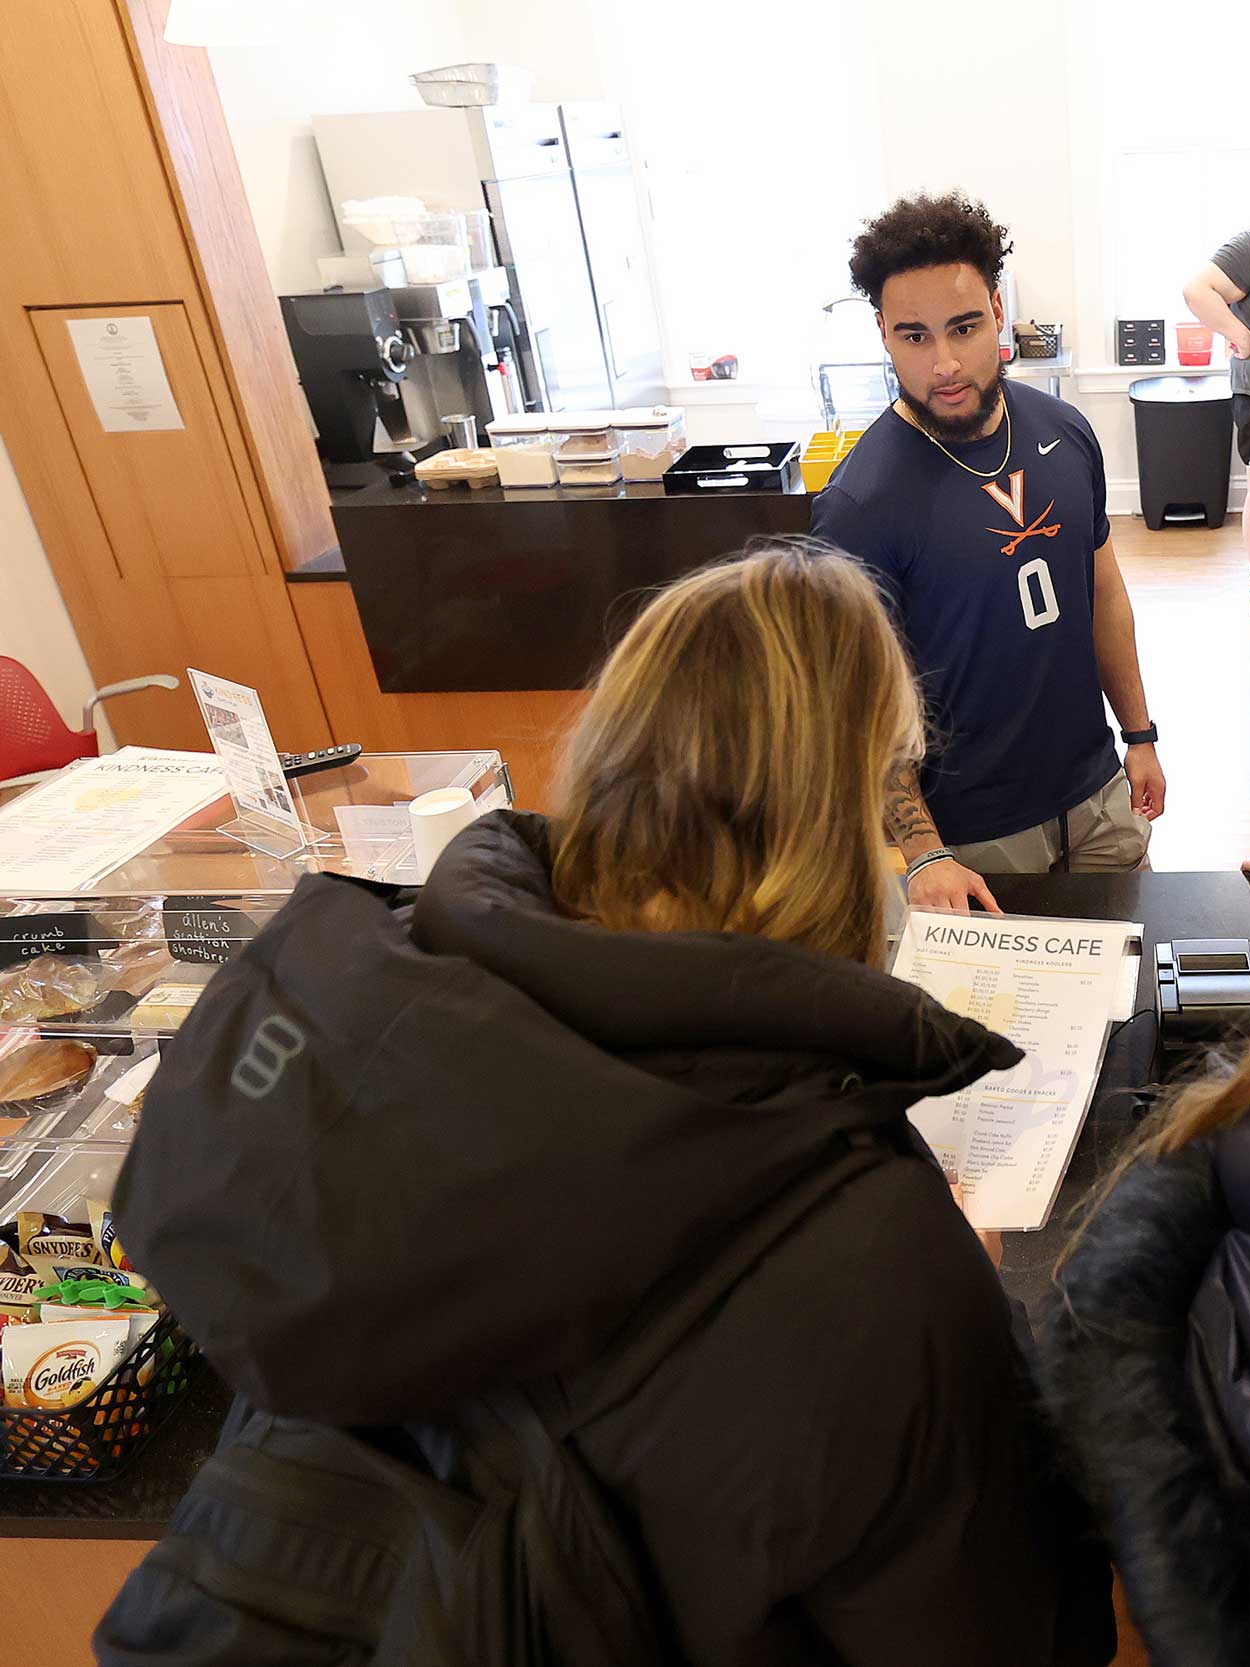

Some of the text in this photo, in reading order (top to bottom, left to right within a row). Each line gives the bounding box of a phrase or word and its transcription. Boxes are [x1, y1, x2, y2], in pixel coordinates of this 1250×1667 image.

[1018, 557, 1060, 630] 0
[94, 763, 185, 774] KINDNESS
[13, 926, 65, 941] crumb
[924, 926, 1104, 957] KINDNESS CAFE
[21, 943, 66, 956] cake
[172, 943, 229, 963] shortbre
[35, 1357, 95, 1391] Goldfish
